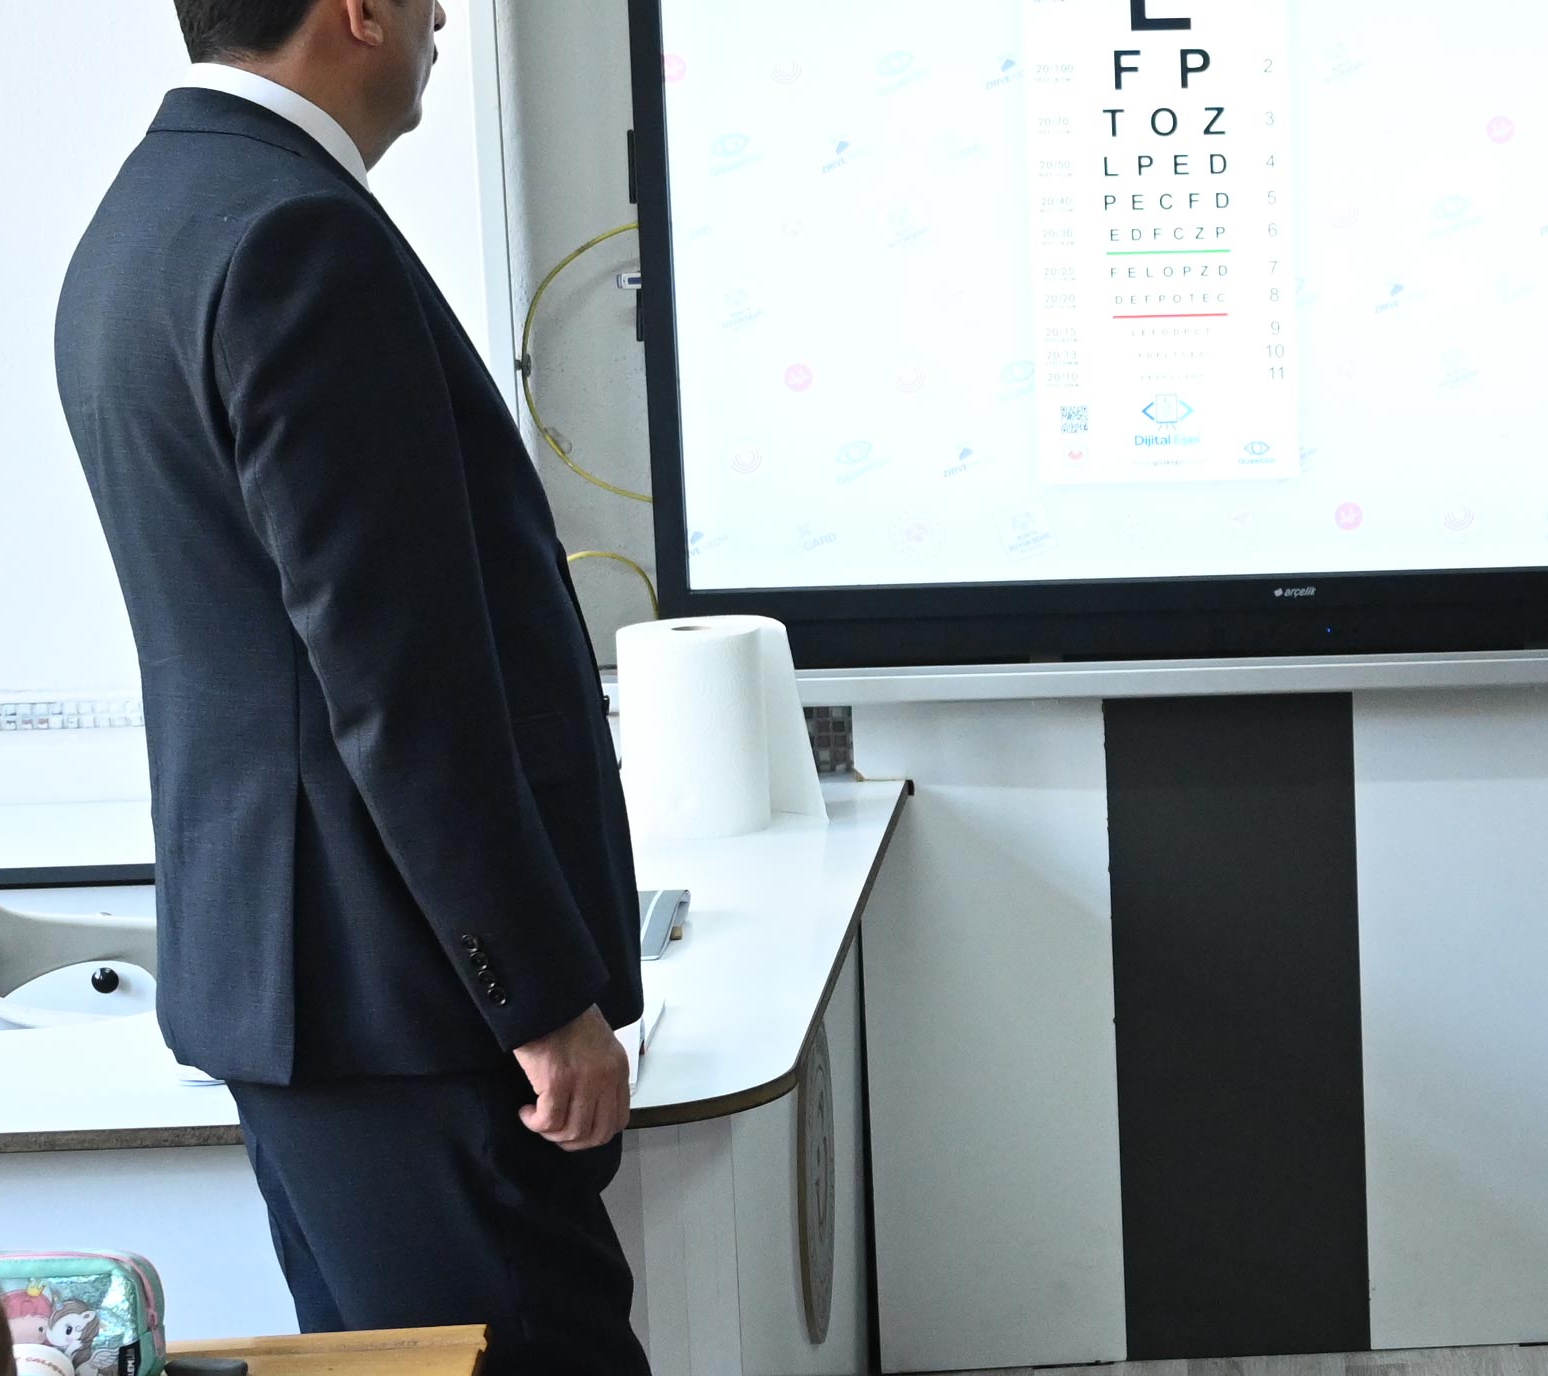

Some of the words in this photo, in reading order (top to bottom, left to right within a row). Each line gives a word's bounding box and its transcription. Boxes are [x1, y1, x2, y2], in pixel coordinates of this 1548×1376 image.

[1114, 50, 1141, 90] F
[1180, 48, 1211, 89] P
[1263, 59, 1273, 73] 2
[1265, 111, 1274, 126] 3
[1266, 155, 1275, 168] 4
[1267, 190, 1277, 205] 5
[1268, 223, 1278, 237] 6
[1268, 260, 1278, 274] 7
[1269, 288, 1279, 303] 8
[1270, 320, 1280, 336] 9
[1266, 344, 1285, 358] 10
[1268, 366, 1285, 381] 11
[1134, 434, 1171, 447] Dijital
[1284, 586, 1316, 598] arçelik
